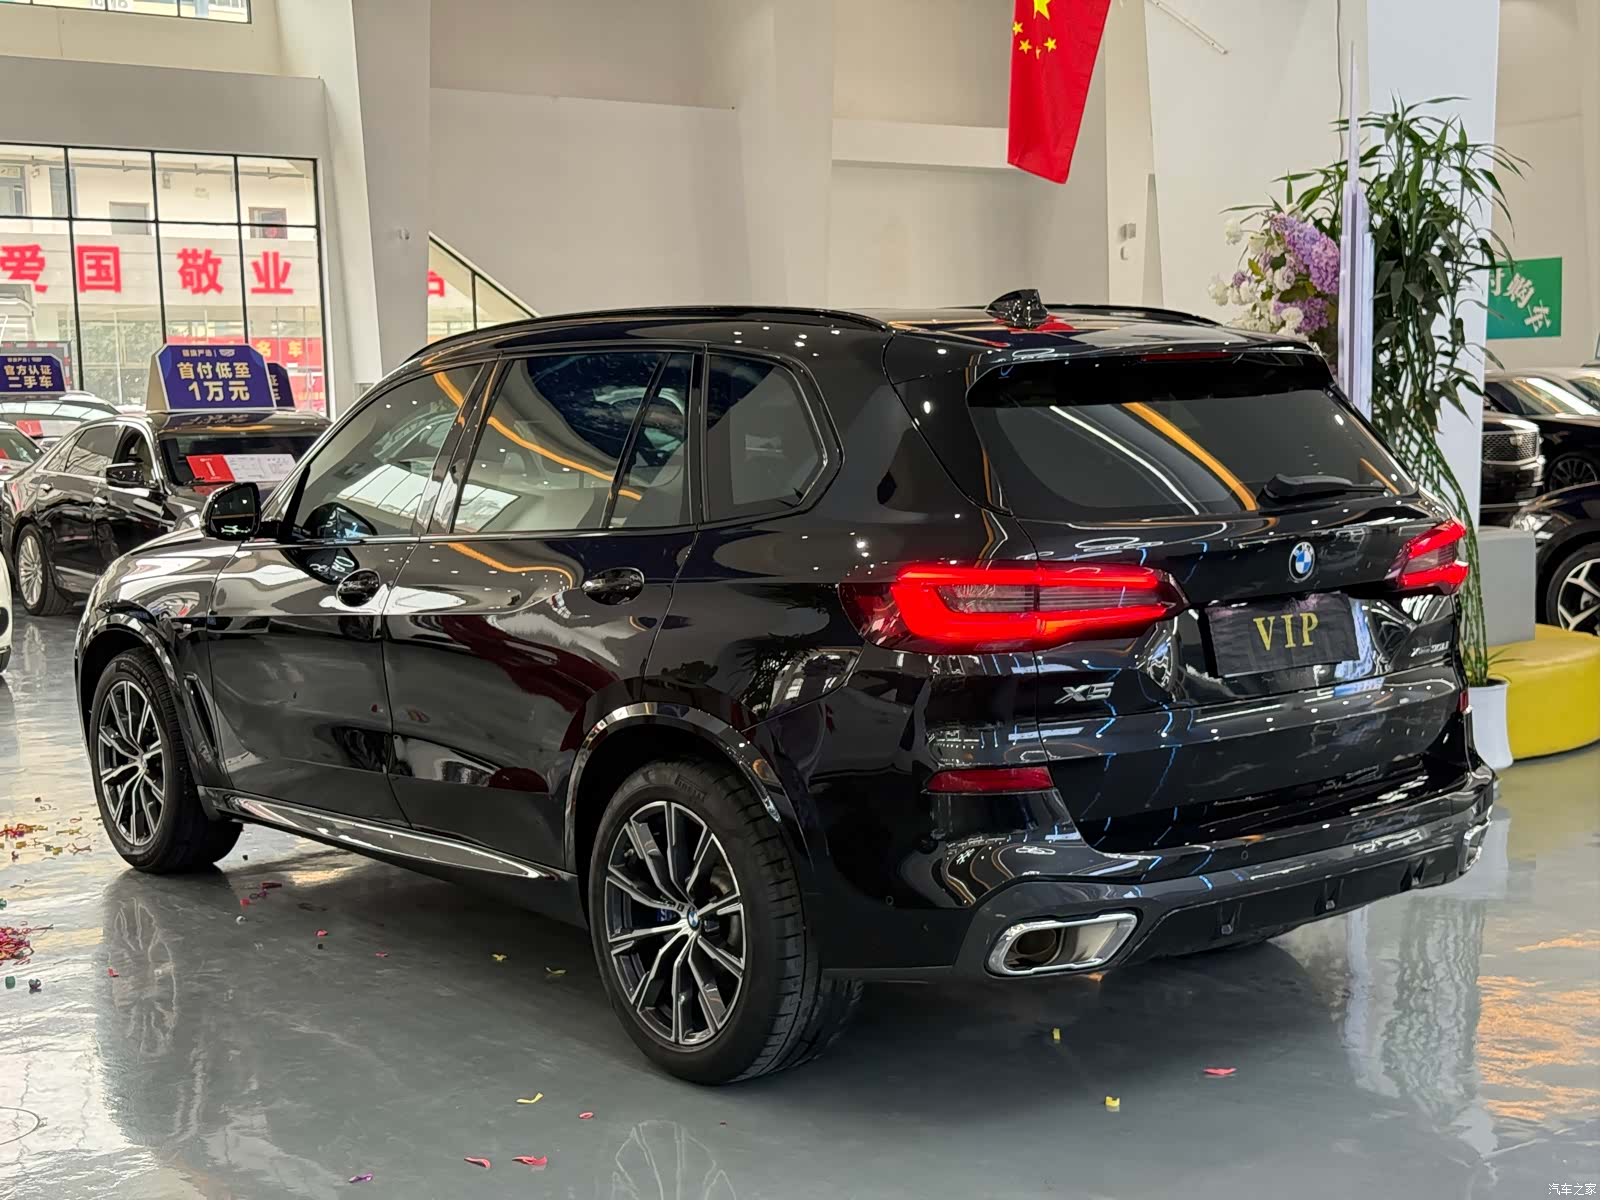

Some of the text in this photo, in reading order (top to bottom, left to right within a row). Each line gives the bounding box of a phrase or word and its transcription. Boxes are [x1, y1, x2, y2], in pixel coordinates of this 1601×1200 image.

[4, 364, 53, 376] 官方认证
[177, 362, 251, 379] 首付低至
[8, 376, 53, 389] 二手车
[188, 381, 250, 402] 1万元
[1253, 612, 1319, 651] VIP
[1054, 681, 1115, 704] X5
